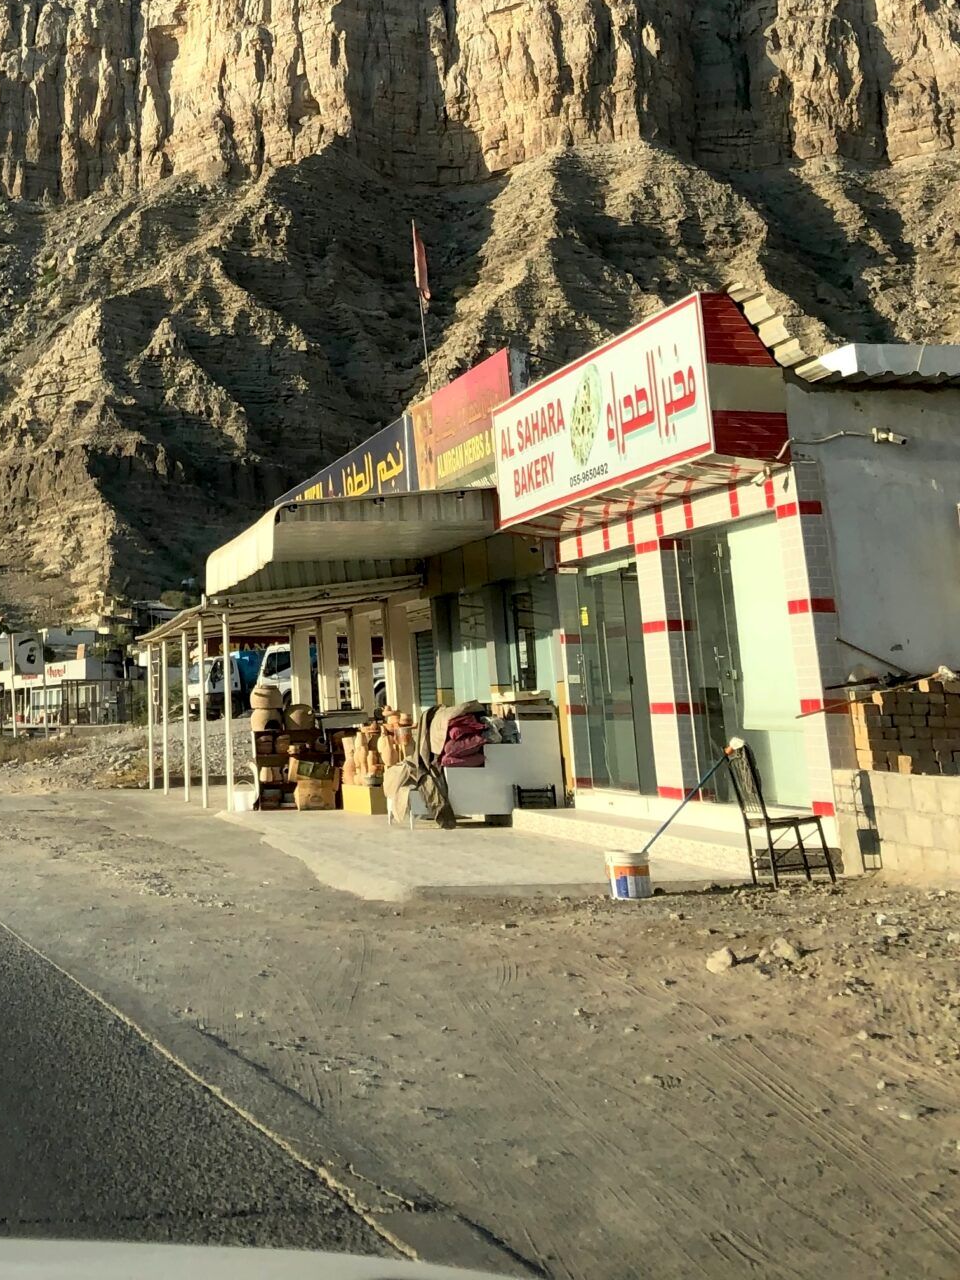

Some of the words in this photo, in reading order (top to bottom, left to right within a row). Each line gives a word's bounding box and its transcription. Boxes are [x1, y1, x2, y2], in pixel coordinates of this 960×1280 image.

[607, 349, 662, 455] الصحراء
[658, 343, 696, 438] مخبز
[463, 433, 484, 466] HERBS
[501, 426, 515, 461] AL
[516, 398, 566, 453] SAHARA
[377, 440, 404, 495] نجم
[513, 451, 555, 497] BAKERY
[569, 462, 609, 488] 055-9650492
